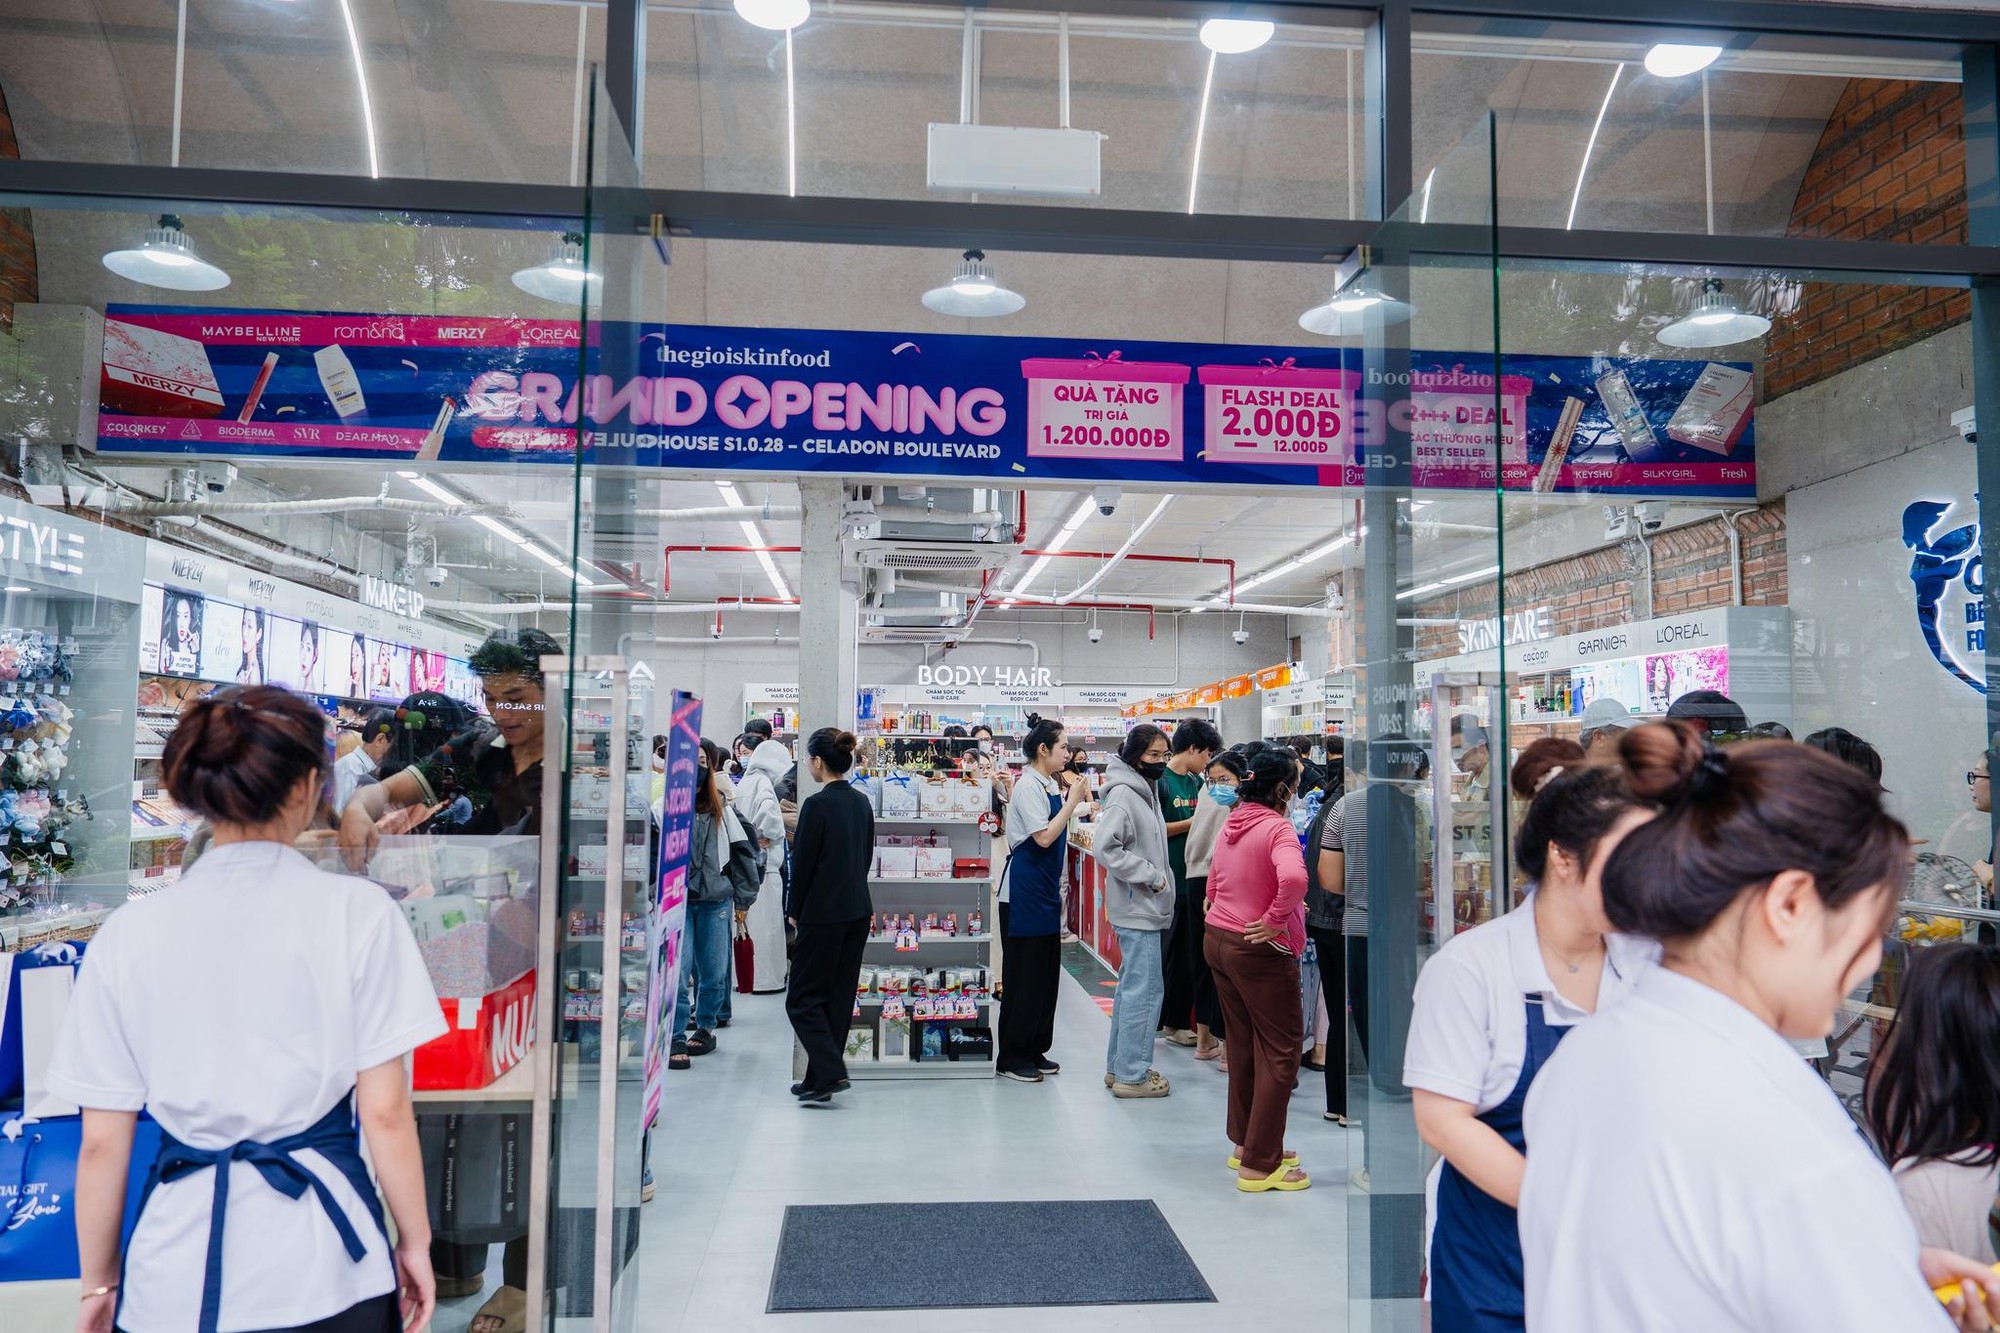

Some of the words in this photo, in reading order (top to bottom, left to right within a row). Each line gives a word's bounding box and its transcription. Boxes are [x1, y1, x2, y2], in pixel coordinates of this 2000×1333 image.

[202, 326, 301, 337] MAYBELLINE
[437, 327, 487, 339] MERZY
[656, 345, 831, 368] thegioiskinfood
[132, 373, 196, 397] MERZY
[1103, 384, 1160, 406] TẶNG
[1221, 388, 1285, 407] FLASH
[1290, 391, 1341, 409] DEAL
[468, 370, 708, 426] GRAND
[714, 375, 1007, 437] OPENING
[106, 422, 167, 435] COLORKEY
[1221, 406, 1341, 439] 2.000Đ
[218, 426, 276, 438] BIODERMA
[292, 427, 321, 441] SVR
[1042, 424, 1171, 448] 1.200.000Đ
[723, 437, 785, 454] S1.0.28
[802, 438, 890, 455] CELADON
[893, 442, 1002, 460] BOULEVARD
[1273, 439, 1329, 454] 12.000Đ
[1416, 446, 1444, 456] BEST
[1446, 447, 1486, 458] SELLER
[1642, 469, 1697, 478] SILKYGIRL
[1720, 467, 1747, 479] Fresh
[172, 556, 206, 583] MERZY
[1522, 649, 1550, 663] cocoon
[918, 664, 988, 686] BODY
[22, 1182, 49, 1195] GIFT
